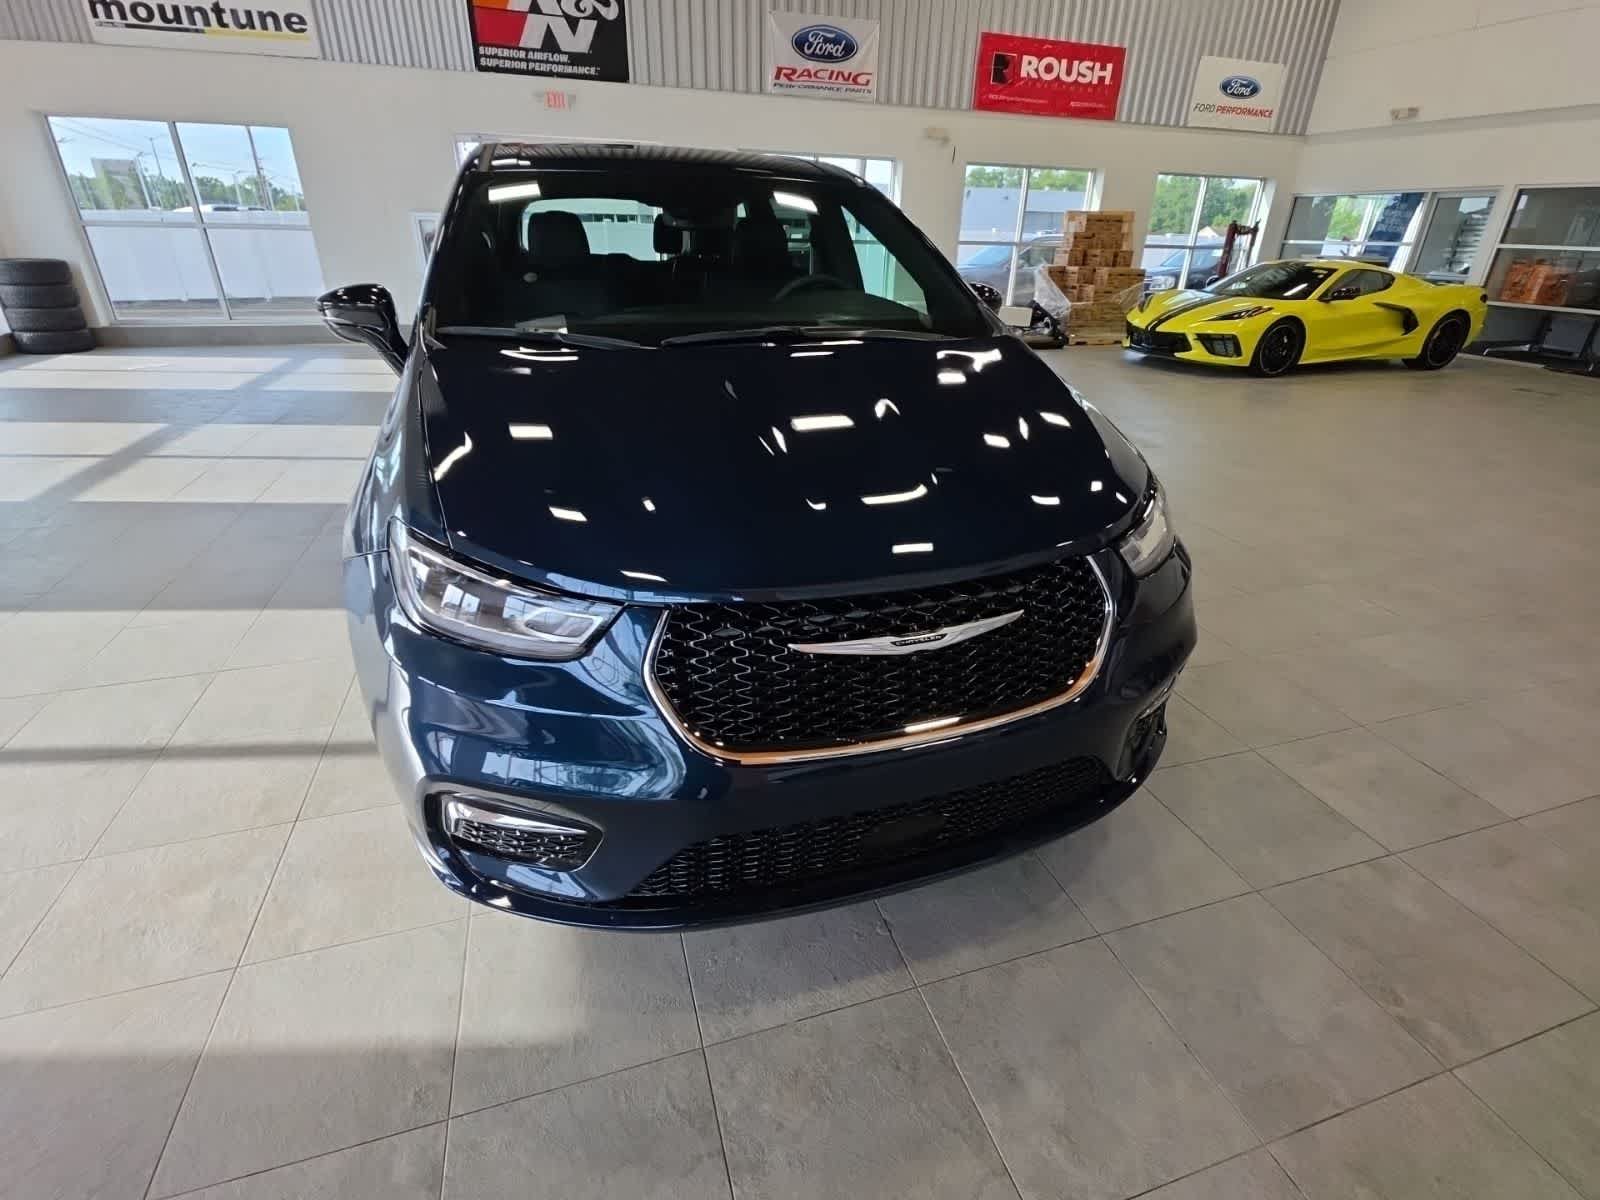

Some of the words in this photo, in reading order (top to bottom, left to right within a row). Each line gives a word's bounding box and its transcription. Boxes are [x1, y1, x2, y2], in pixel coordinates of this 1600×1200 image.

[88, 0, 308, 33] mountune
[804, 30, 846, 57] Ford
[479, 47, 526, 59] SUPERIOR
[528, 51, 571, 63] AIRFLOW.
[480, 57, 527, 70] SUPERIOR
[774, 66, 873, 86] RACING
[1020, 54, 1113, 85] ROUSH
[1227, 79, 1255, 96] Ford
[1193, 103, 1215, 113] FORD
[1216, 105, 1274, 118] PERFORMANCE
